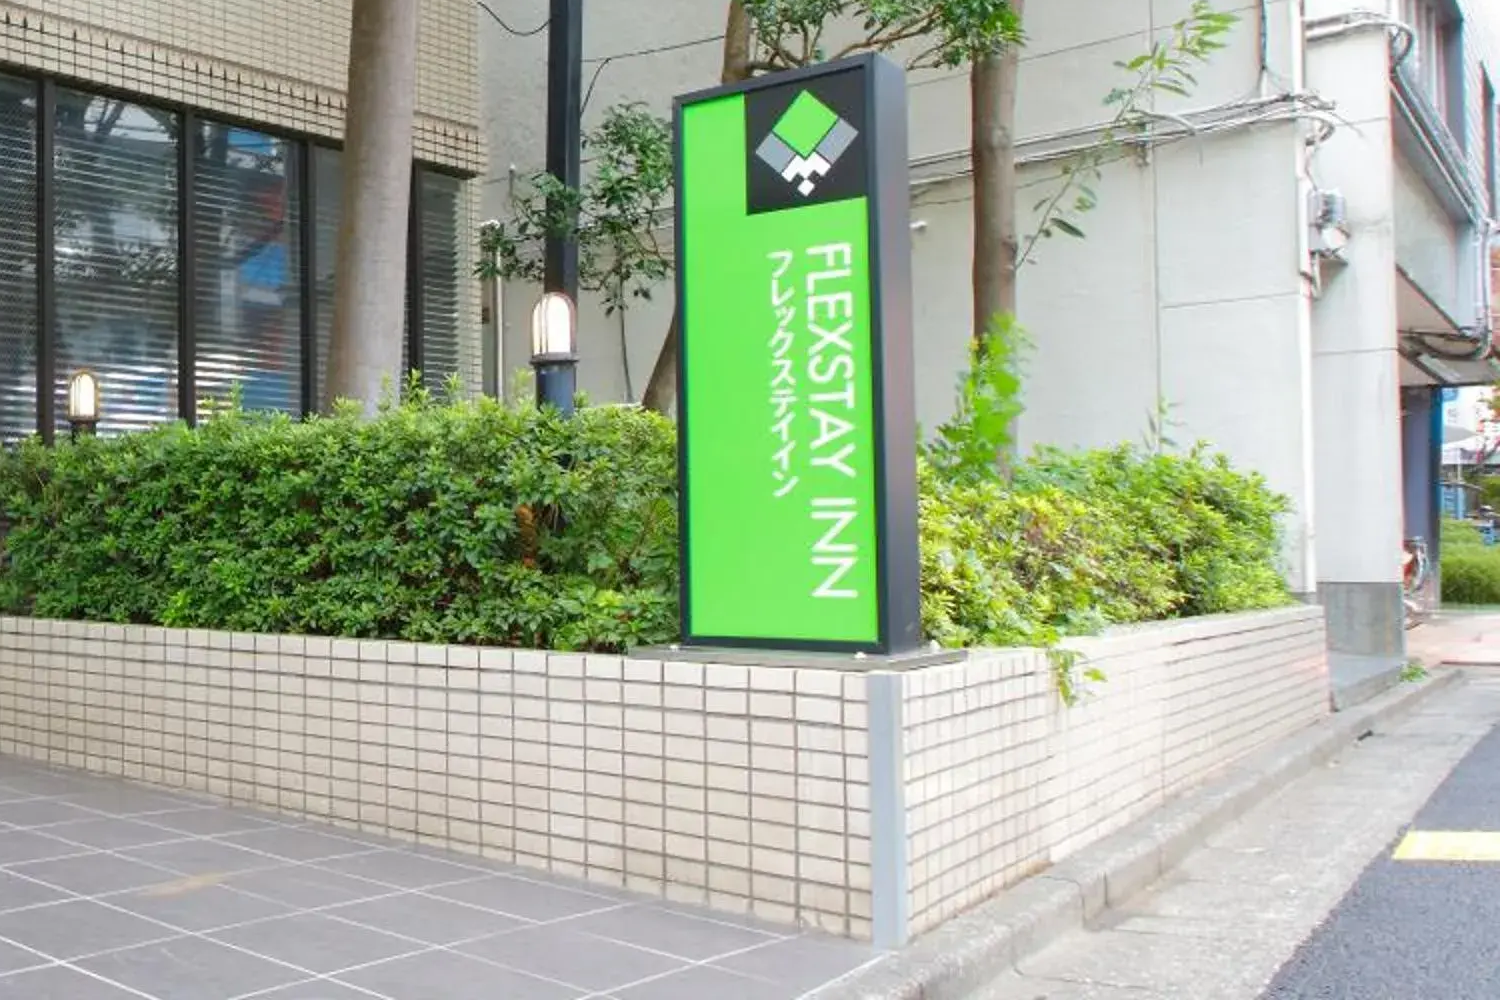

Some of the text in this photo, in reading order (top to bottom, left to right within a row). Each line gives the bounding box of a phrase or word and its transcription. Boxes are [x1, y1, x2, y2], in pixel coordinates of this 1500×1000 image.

[766, 249, 799, 497] フレックステイイン
[805, 242, 859, 599] FLEXSTAY INN
